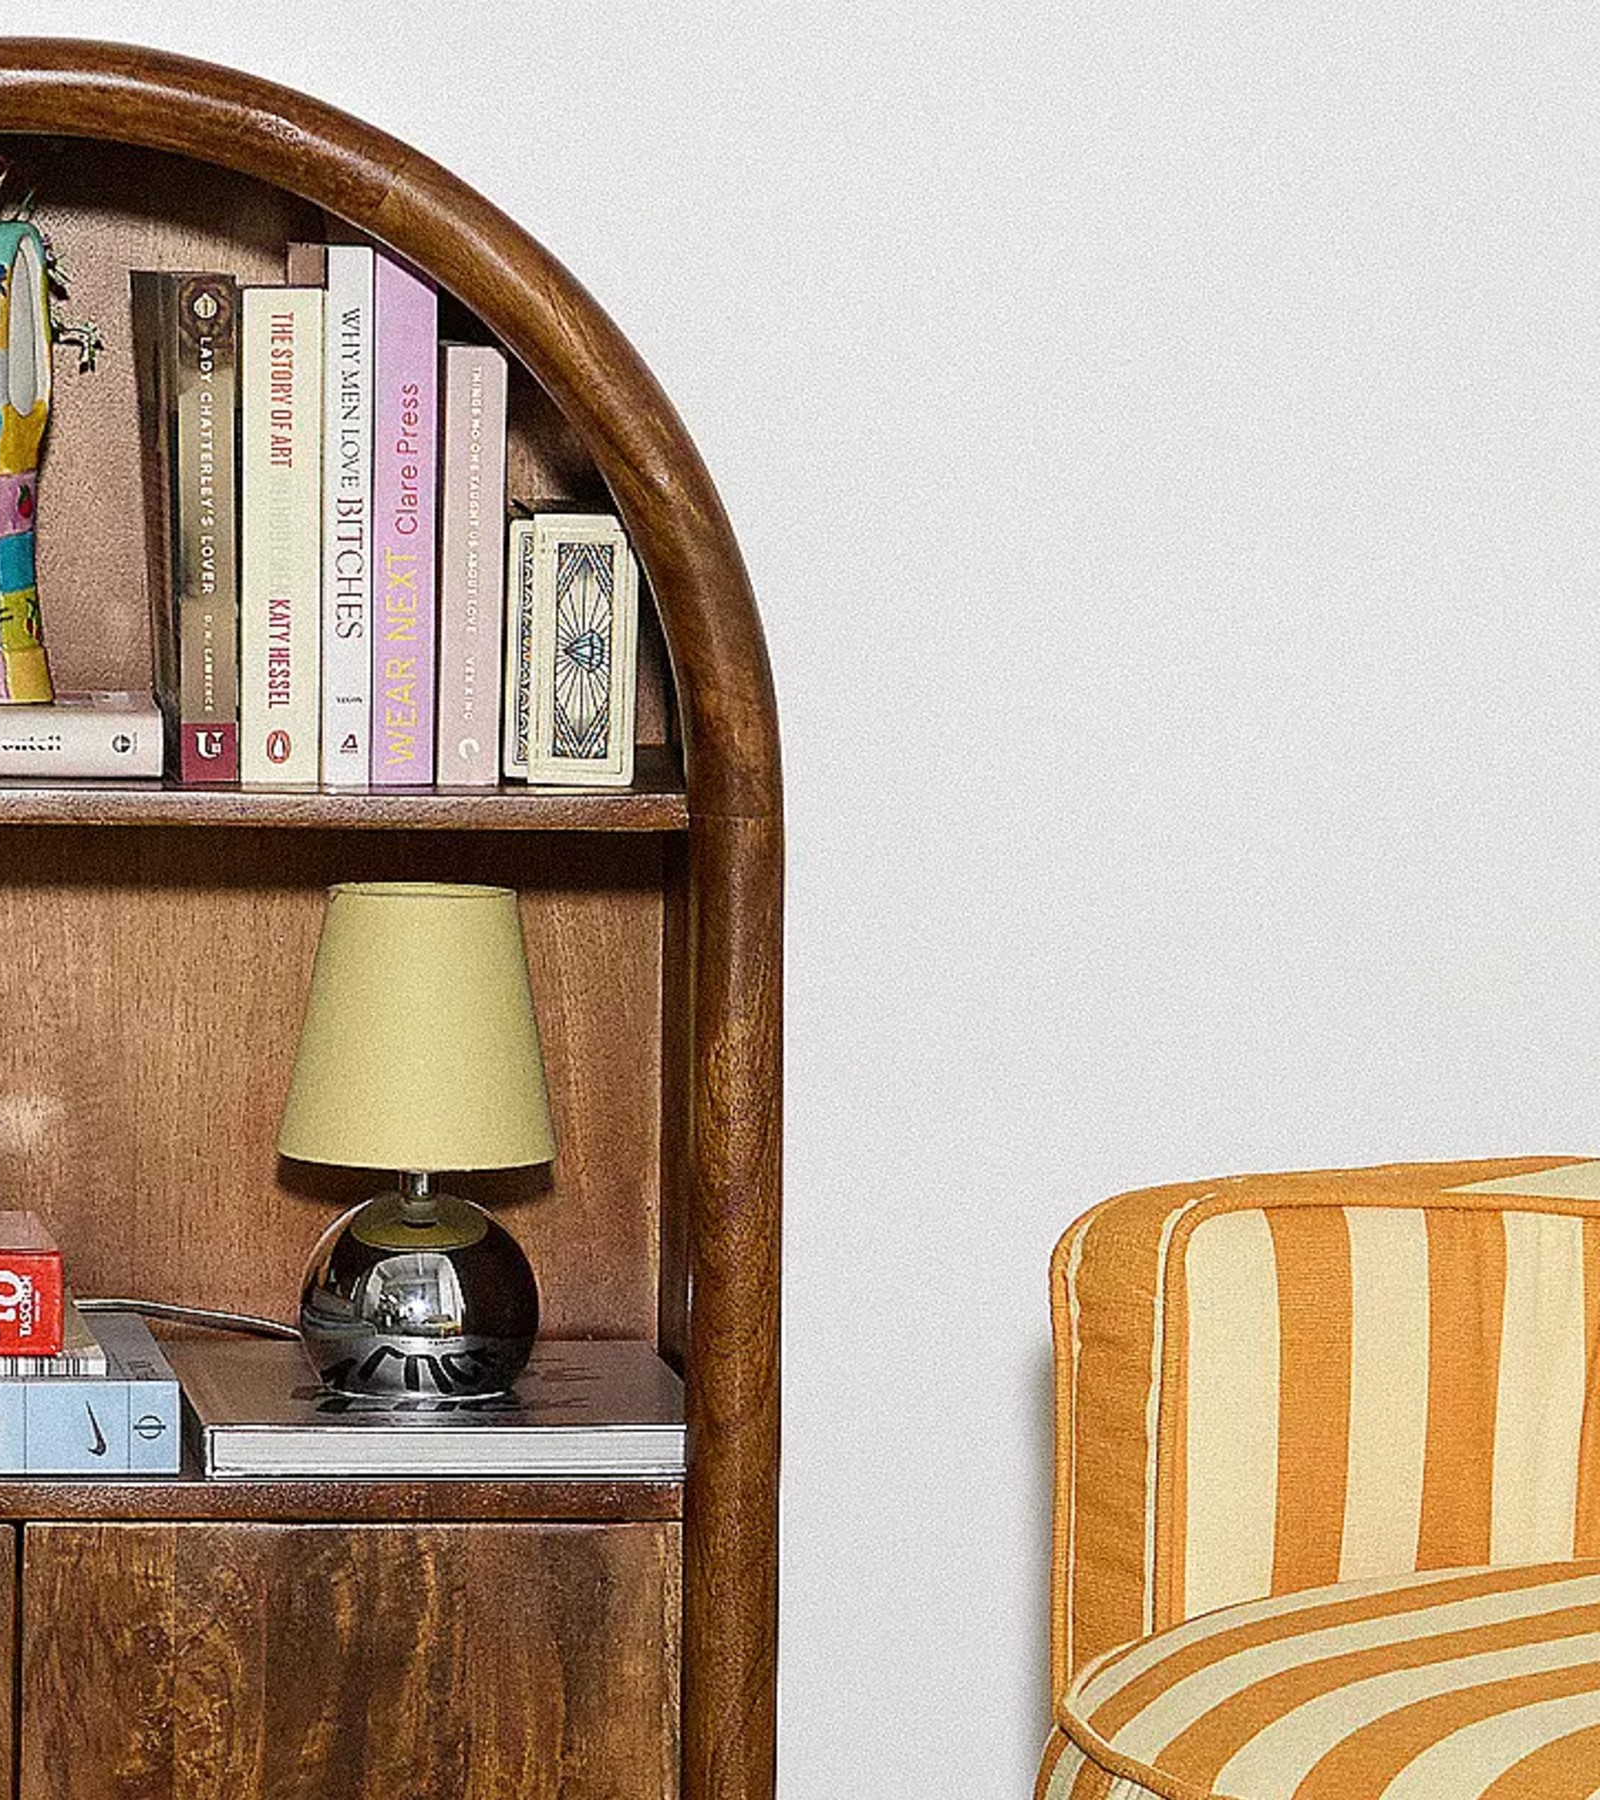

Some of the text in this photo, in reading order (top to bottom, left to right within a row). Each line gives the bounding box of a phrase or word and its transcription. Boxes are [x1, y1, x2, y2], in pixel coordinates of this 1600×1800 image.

[270, 312, 294, 468] THE STORY OF ART
[470, 366, 483, 414] THINGS
[199, 337, 216, 594] LADY CHATTERLEY'S LOVER
[335, 308, 366, 640] WHY MEN LOVE BITCHES
[395, 383, 420, 536] Clare Press
[468, 474, 481, 528] TAUGHT
[465, 600, 478, 633] LOVE
[467, 551, 479, 598] ABOUT
[268, 599, 291, 709] KATY HESSEL
[383, 547, 419, 766] WEAR NEXT
